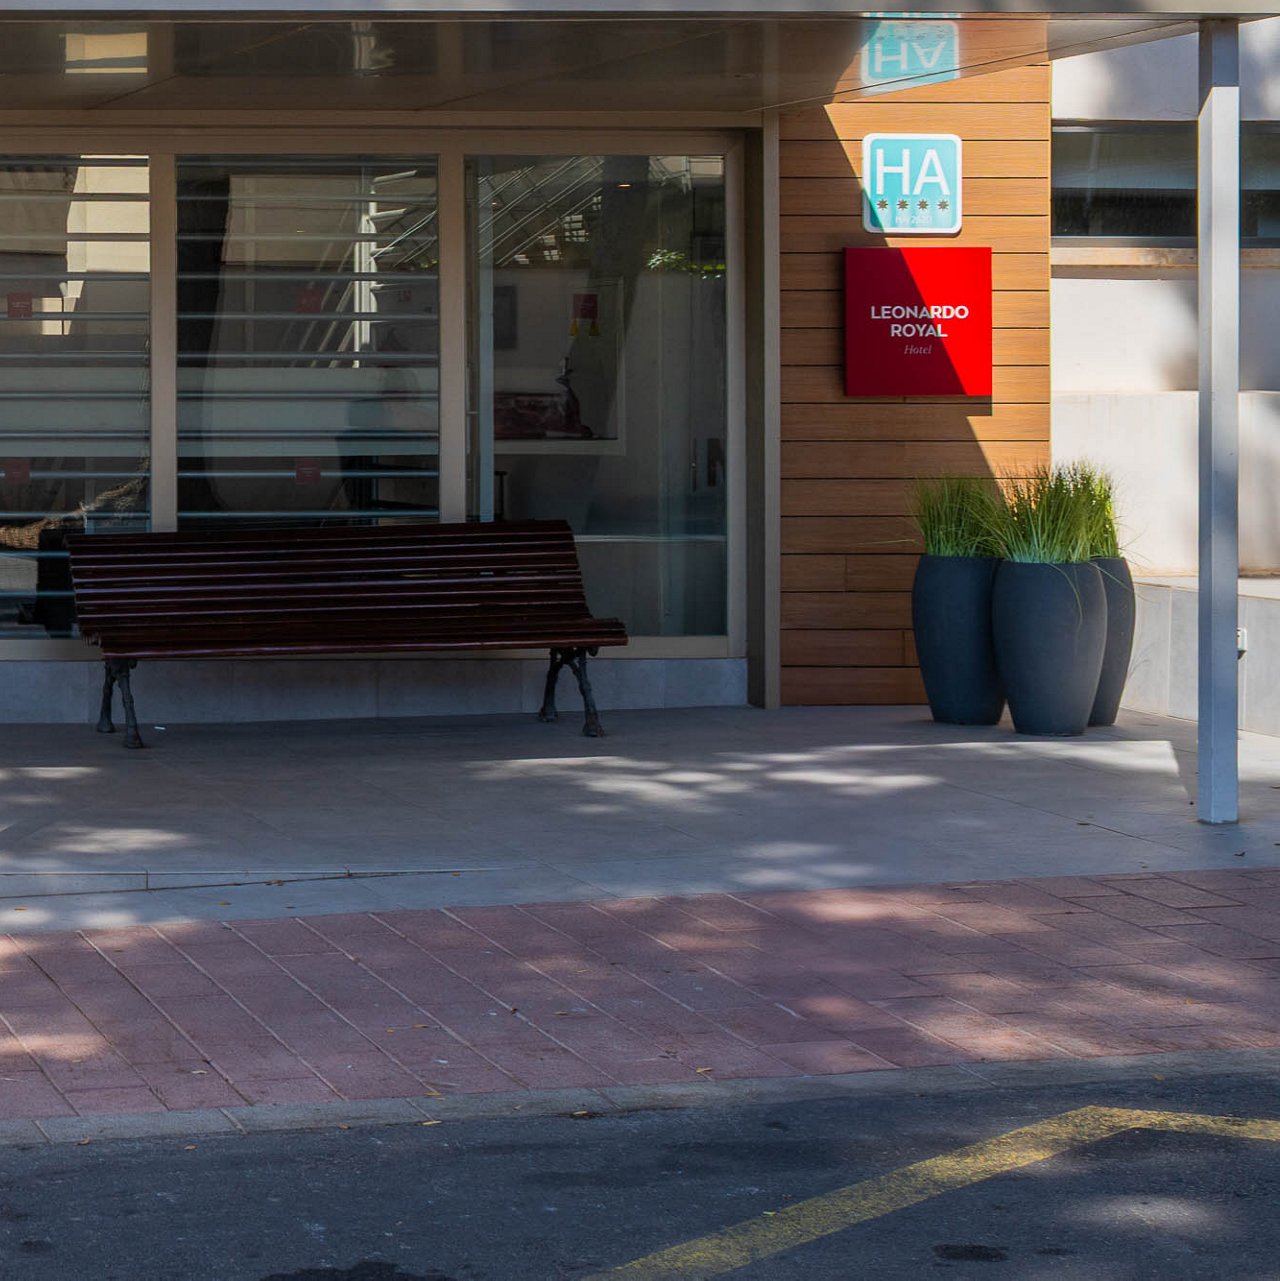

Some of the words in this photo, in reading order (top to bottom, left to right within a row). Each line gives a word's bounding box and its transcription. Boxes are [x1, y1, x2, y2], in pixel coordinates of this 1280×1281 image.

[875, 148, 951, 195] HA
[870, 305, 969, 319] LEONARDO
[890, 323, 948, 337] ROYAL
[903, 344, 932, 355] Hotel
